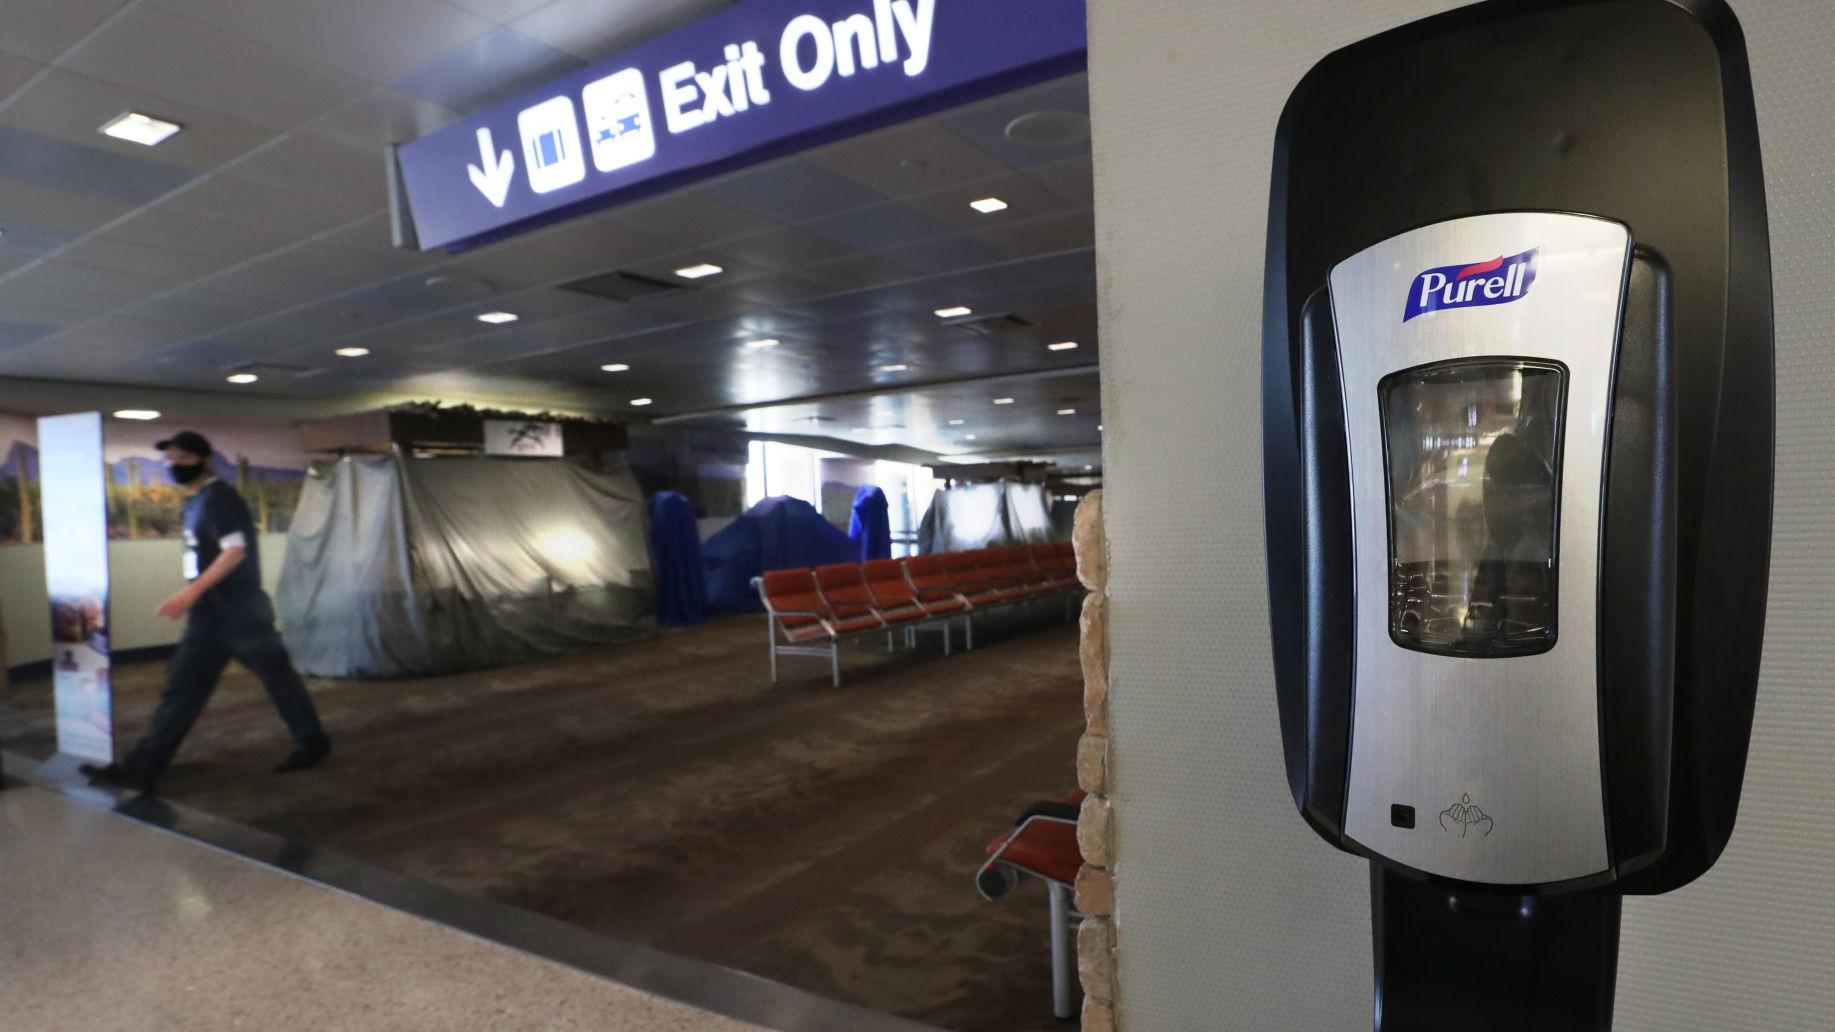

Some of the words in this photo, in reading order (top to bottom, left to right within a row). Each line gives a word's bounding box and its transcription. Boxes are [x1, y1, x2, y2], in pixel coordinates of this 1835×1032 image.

[659, 40, 771, 134] Exit
[779, 0, 935, 91] Only
[1419, 262, 1526, 307] Purell
